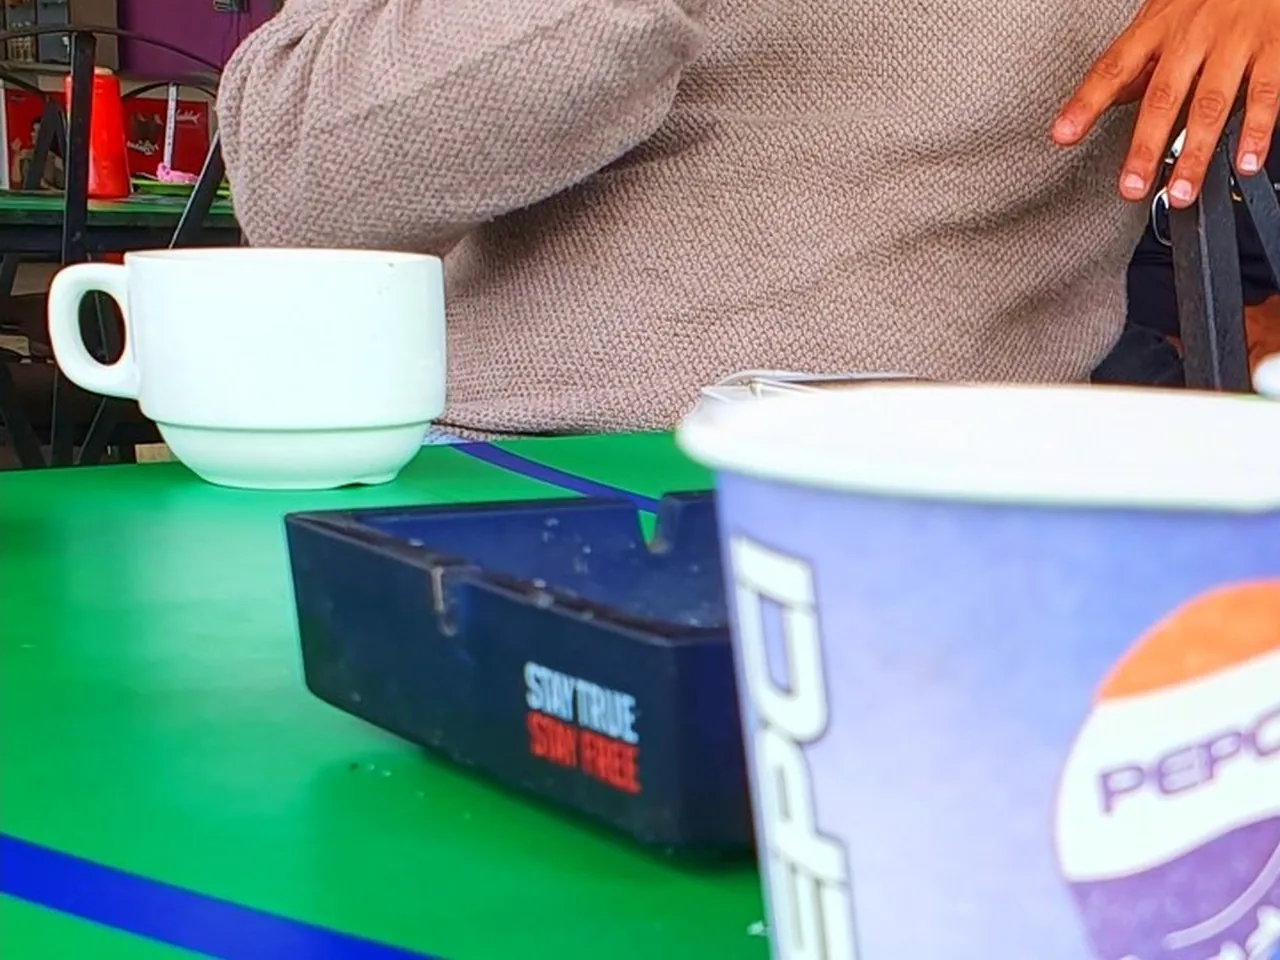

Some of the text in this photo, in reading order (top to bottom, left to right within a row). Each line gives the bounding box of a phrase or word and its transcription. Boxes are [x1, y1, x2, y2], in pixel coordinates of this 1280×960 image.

[524, 661, 640, 744] STAY TRUE
[527, 711, 642, 795] STAY FREE
